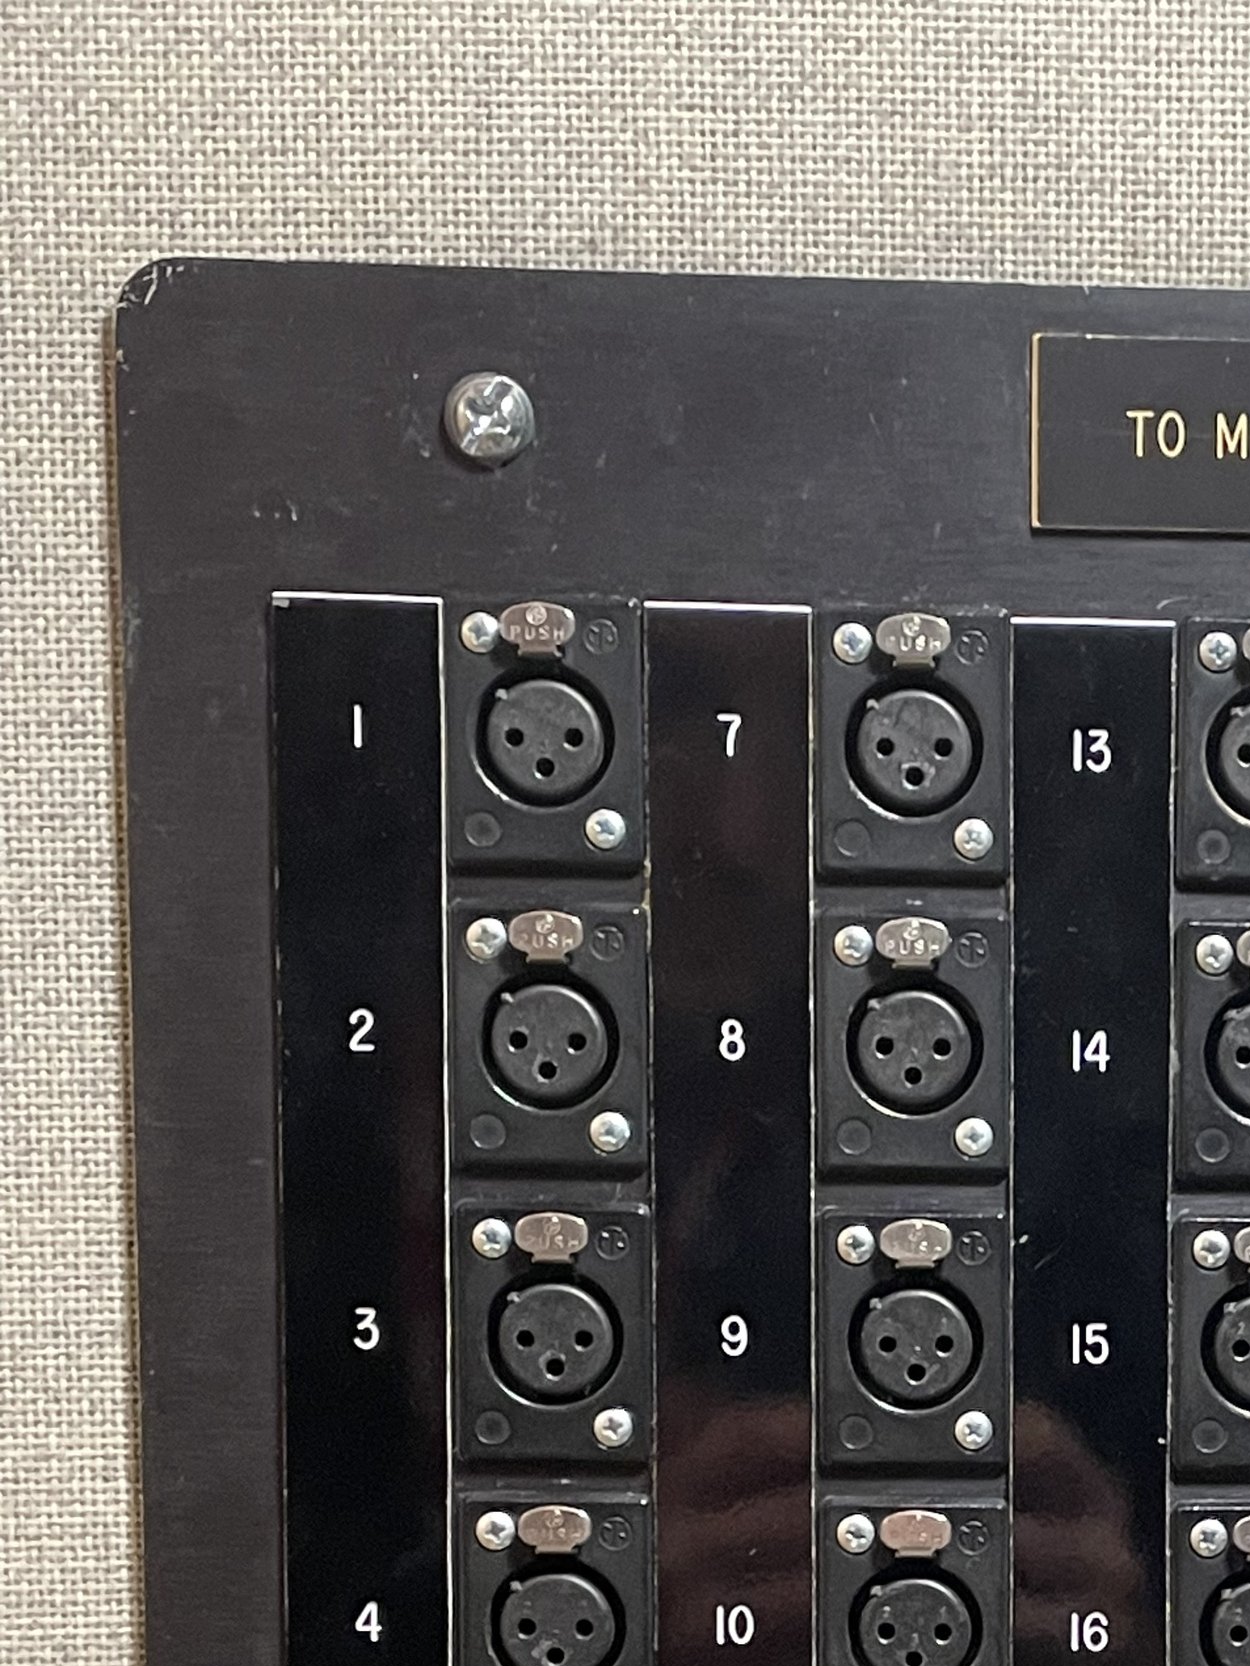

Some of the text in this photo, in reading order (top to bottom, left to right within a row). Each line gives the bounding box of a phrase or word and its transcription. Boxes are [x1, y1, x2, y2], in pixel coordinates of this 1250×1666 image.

[1126, 410, 1187, 458] TO
[1215, 412, 1249, 460] M
[510, 624, 565, 642] PUSH
[352, 703, 364, 750] 1
[716, 713, 742, 758] 7
[1072, 728, 1112, 774] 13
[885, 938, 941, 956] PUSH
[348, 1008, 376, 1052] 2
[718, 1018, 746, 1062] 8
[1072, 1029, 1111, 1073] 14
[353, 1307, 380, 1351] 3
[720, 1314, 749, 1357] 9
[1072, 1322, 1110, 1365] 15
[354, 1601, 383, 1643] 4
[716, 1604, 755, 1646] 10
[1070, 1611, 1109, 1653] 16
